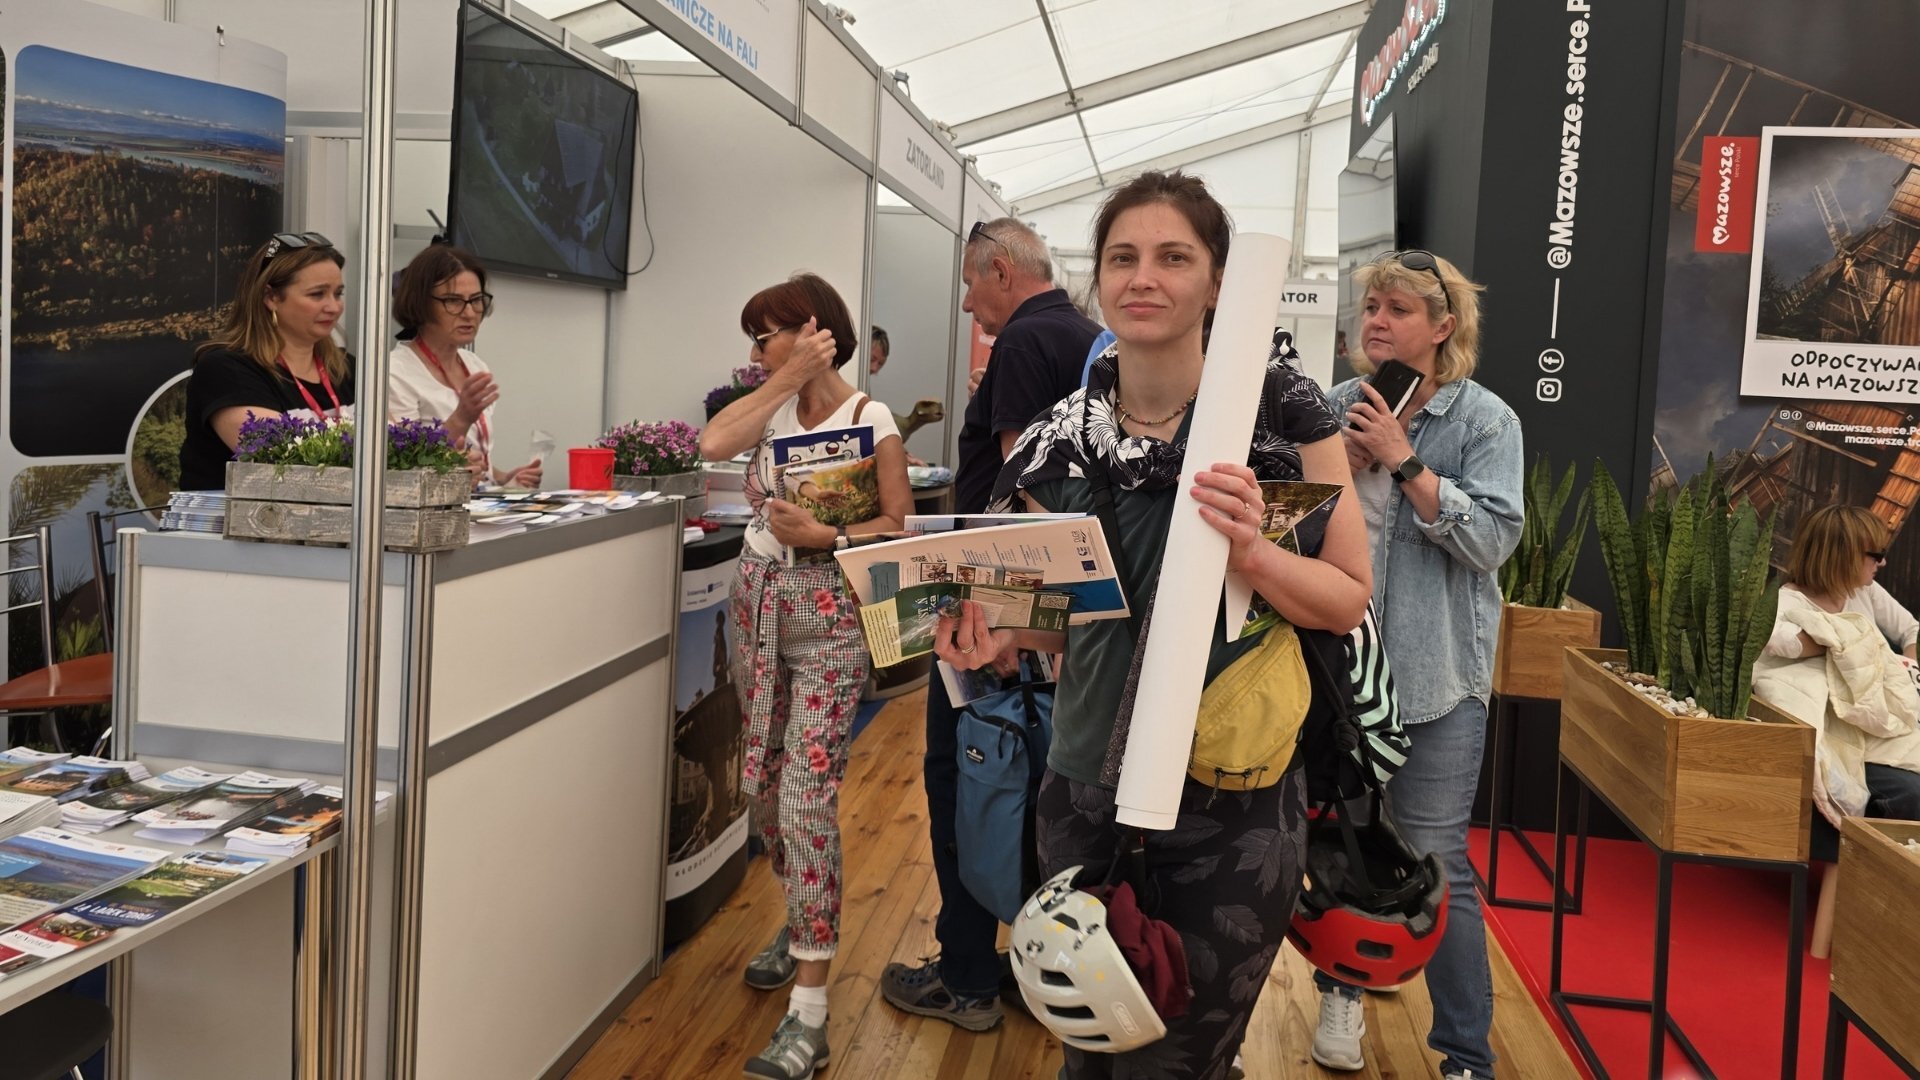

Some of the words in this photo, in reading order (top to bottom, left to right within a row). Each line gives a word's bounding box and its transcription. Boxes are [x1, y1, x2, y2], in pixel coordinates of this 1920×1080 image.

[667, 0, 714, 36] NICZE
[718, 20, 733, 51] NA
[736, 36, 758, 70] FALI
[1791, 350, 1920, 373] ODPOCZYWA
[1781, 372, 1810, 388] NA
